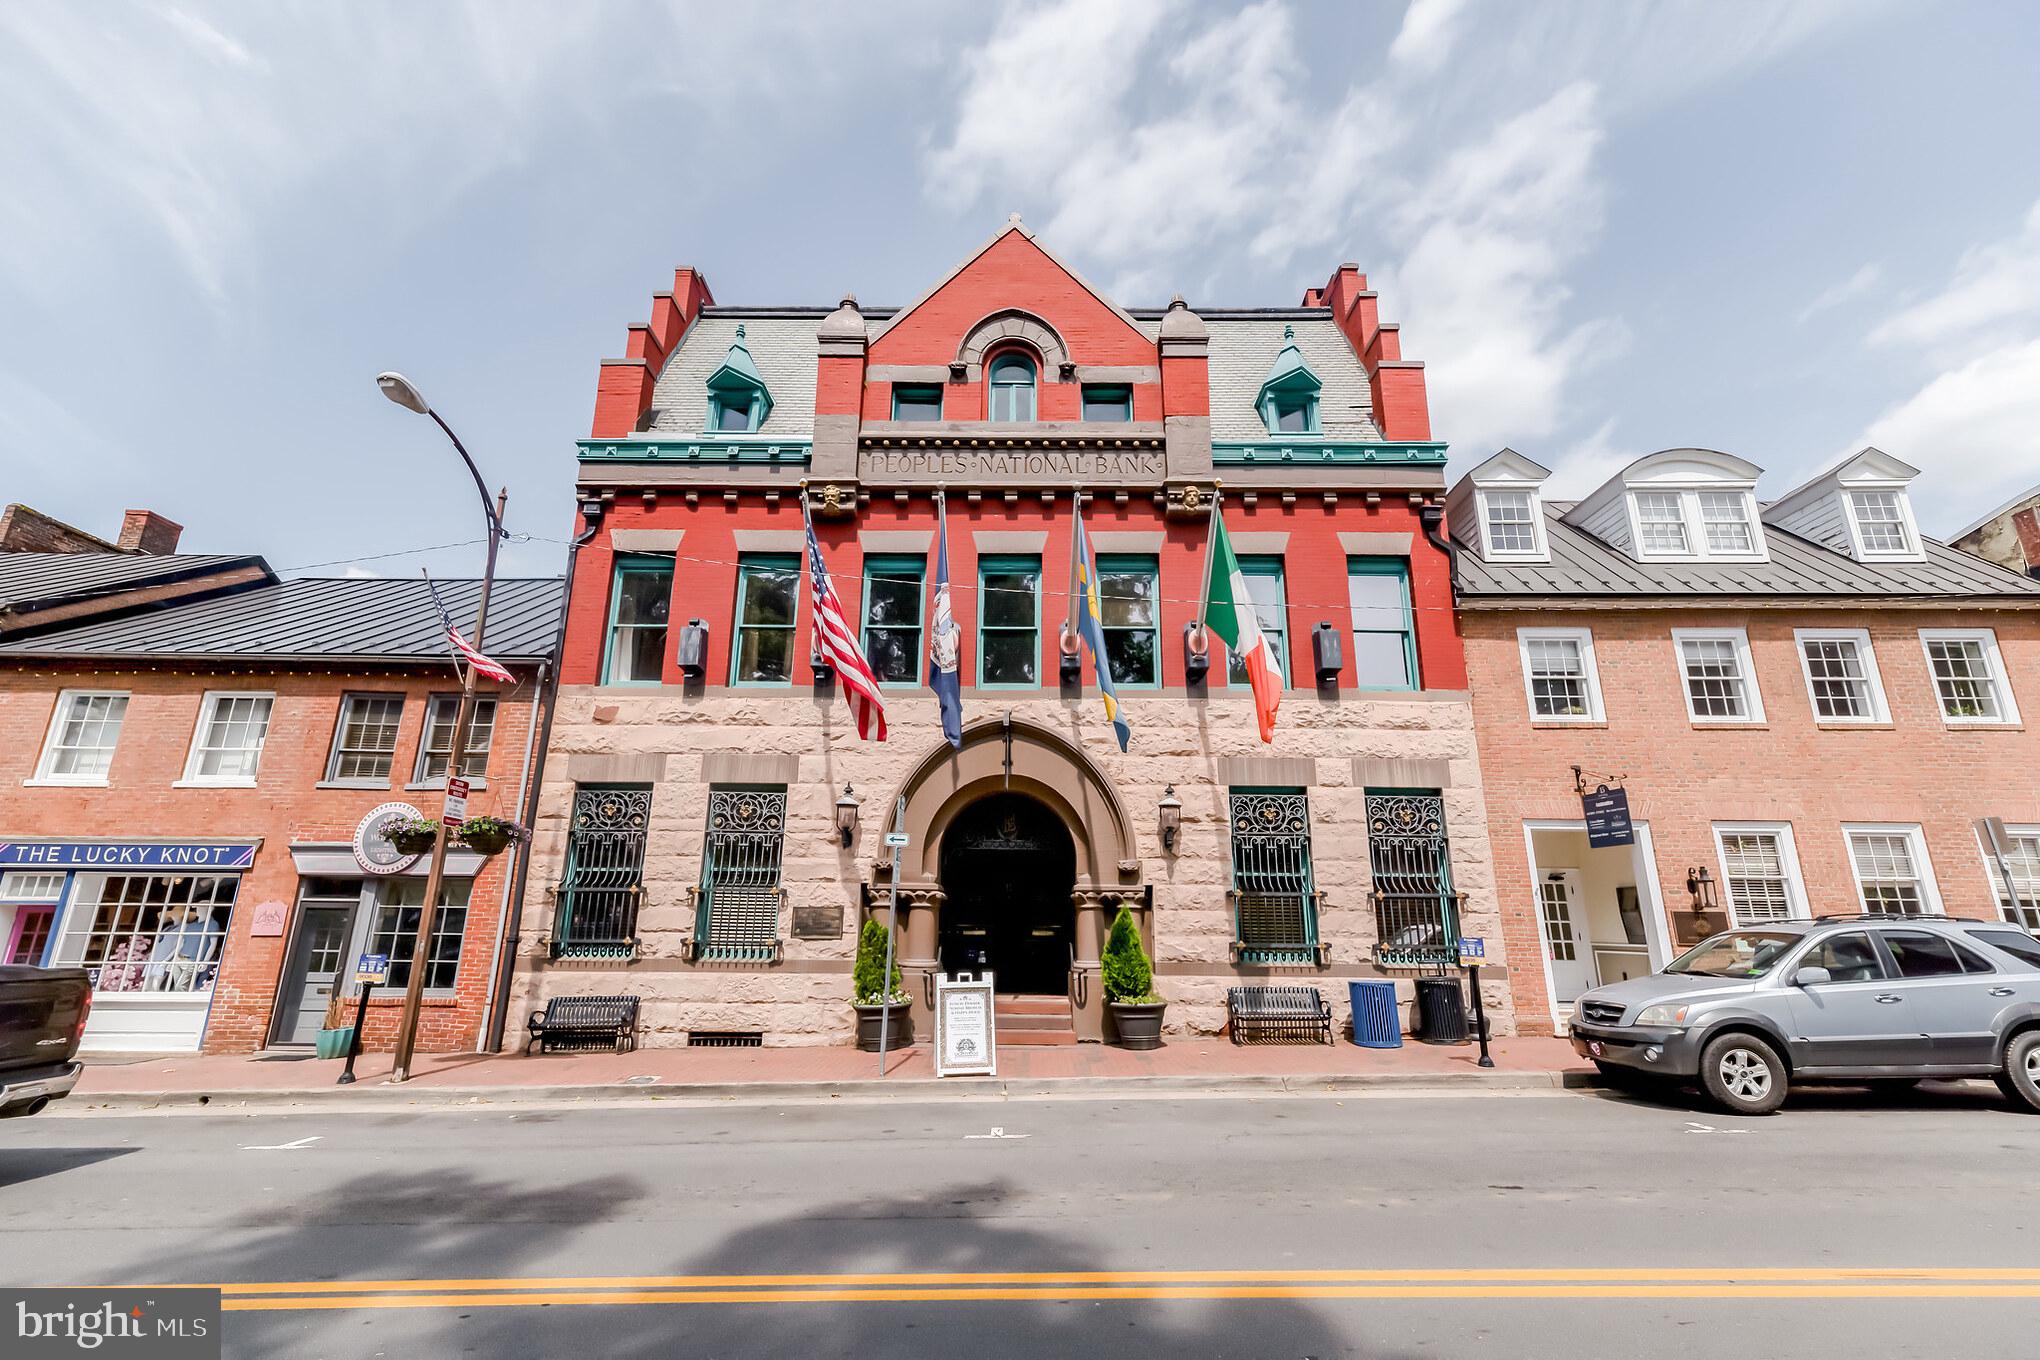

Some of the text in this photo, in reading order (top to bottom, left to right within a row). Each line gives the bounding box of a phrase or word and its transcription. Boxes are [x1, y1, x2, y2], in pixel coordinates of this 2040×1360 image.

[870, 455, 1157, 475] PEOPLES NATIONAL BANK
[16, 846, 62, 862] THE
[72, 847, 151, 863] LUCKY
